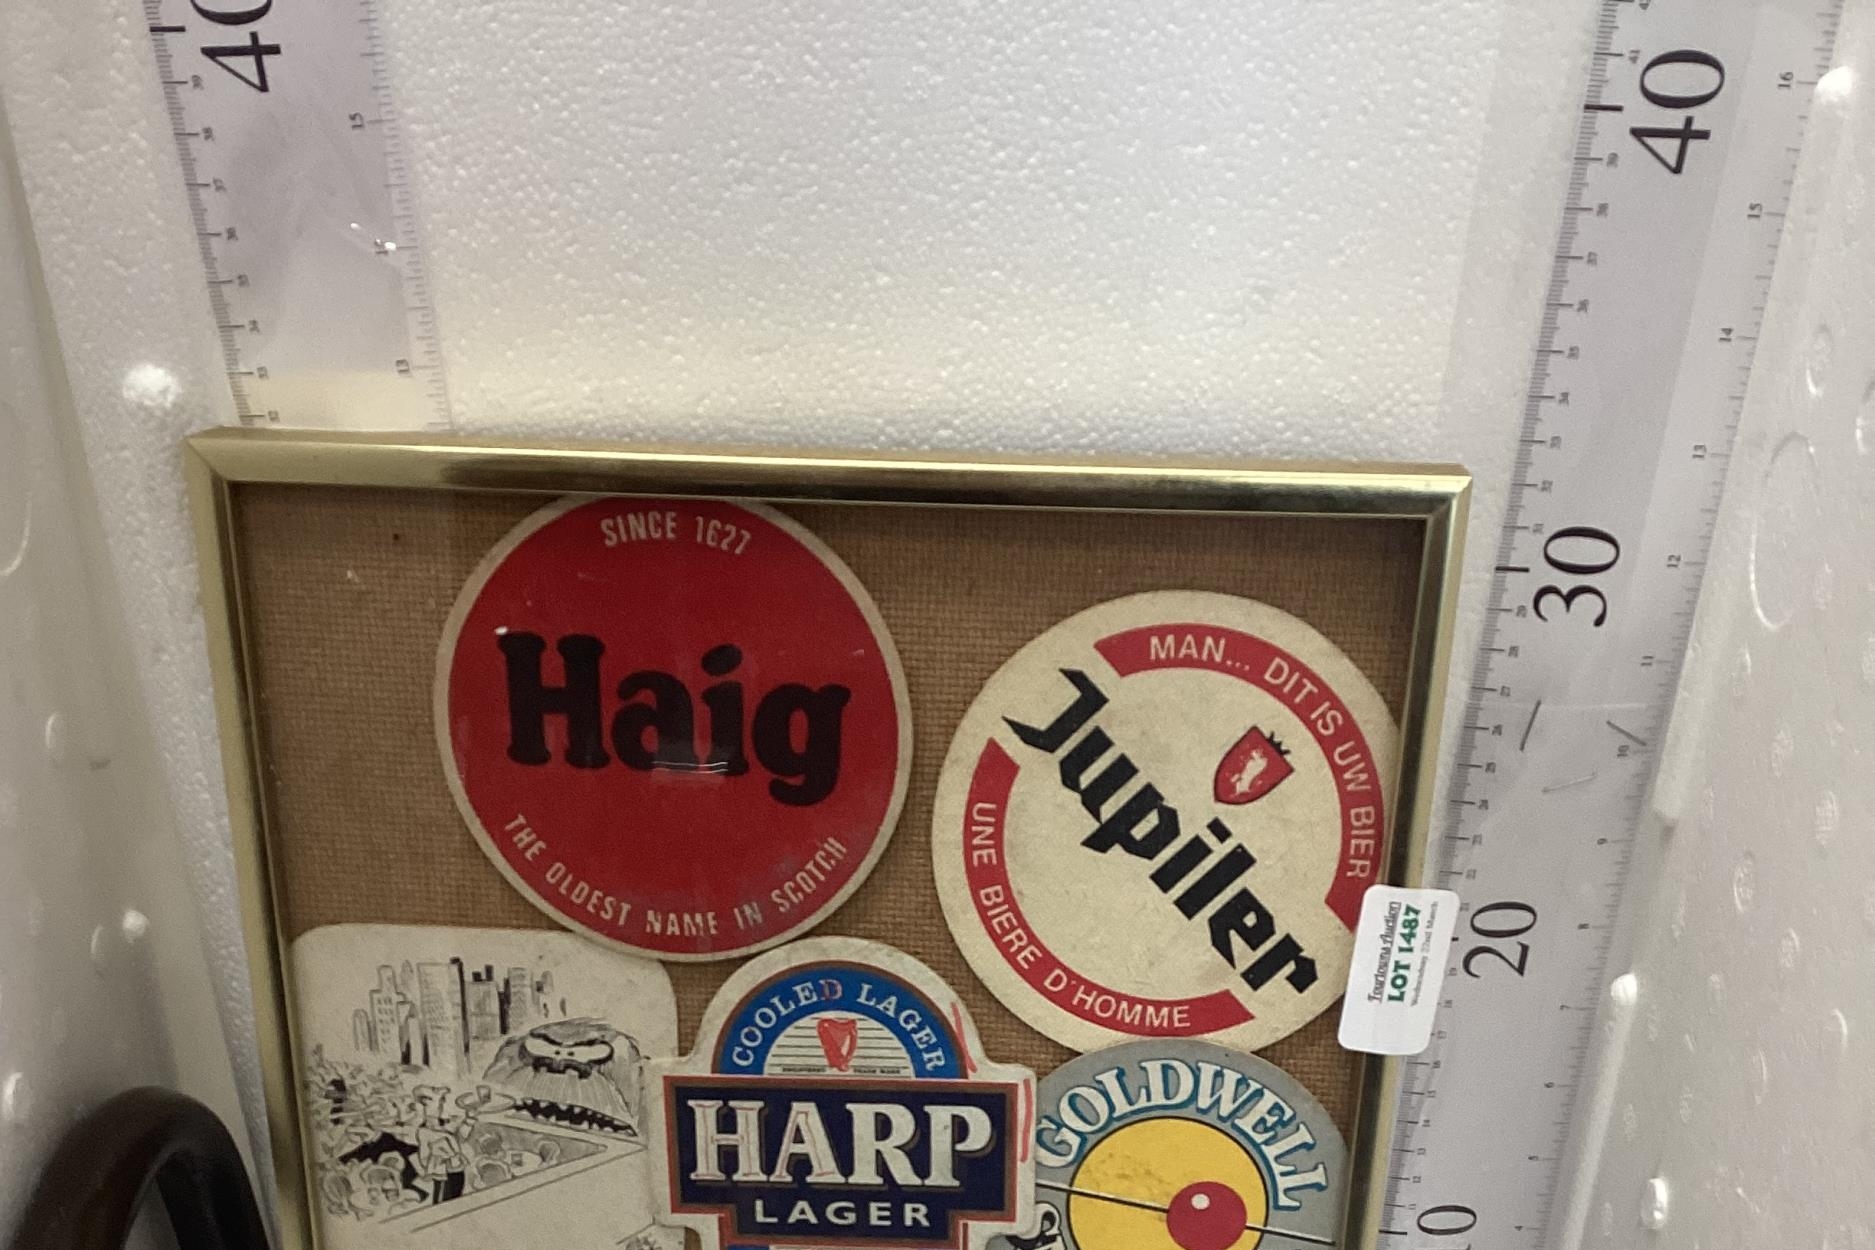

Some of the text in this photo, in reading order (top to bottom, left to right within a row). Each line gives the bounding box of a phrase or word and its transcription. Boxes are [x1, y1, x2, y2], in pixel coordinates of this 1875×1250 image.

[190, 0, 281, 93] 4
[1777, 71, 1794, 89] 16
[348, 112, 365, 130] 15
[1630, 49, 1725, 174] 40
[1746, 202, 1763, 219] 15
[1718, 327, 1734, 343] 14
[1691, 444, 1708, 459] 13
[602, 511, 752, 556] SINCE 1627
[1666, 554, 1682, 569] 12
[1533, 526, 1620, 627] 30
[1264, 657, 1318, 704] DIT
[1640, 655, 1655, 667] 11
[499, 631, 851, 807] Haig
[1310, 702, 1344, 737] IS
[1333, 741, 1372, 792] UW
[971, 803, 997, 867] UNE
[1002, 667, 1318, 994] Jupiler
[1346, 808, 1375, 879] BIER
[504, 813, 848, 938] THE OLDEST NAME IN SCOTCH
[981, 886, 1042, 971] BIERE
[1387, 904, 1421, 1002] LOT 1487
[1462, 901, 1537, 979] 20
[732, 979, 947, 1071] COOLED LAGER
[688, 1099, 993, 1188] HARP
[1036, 1058, 1328, 1211] GOLDWELL
[755, 1199, 931, 1227] LAGER
